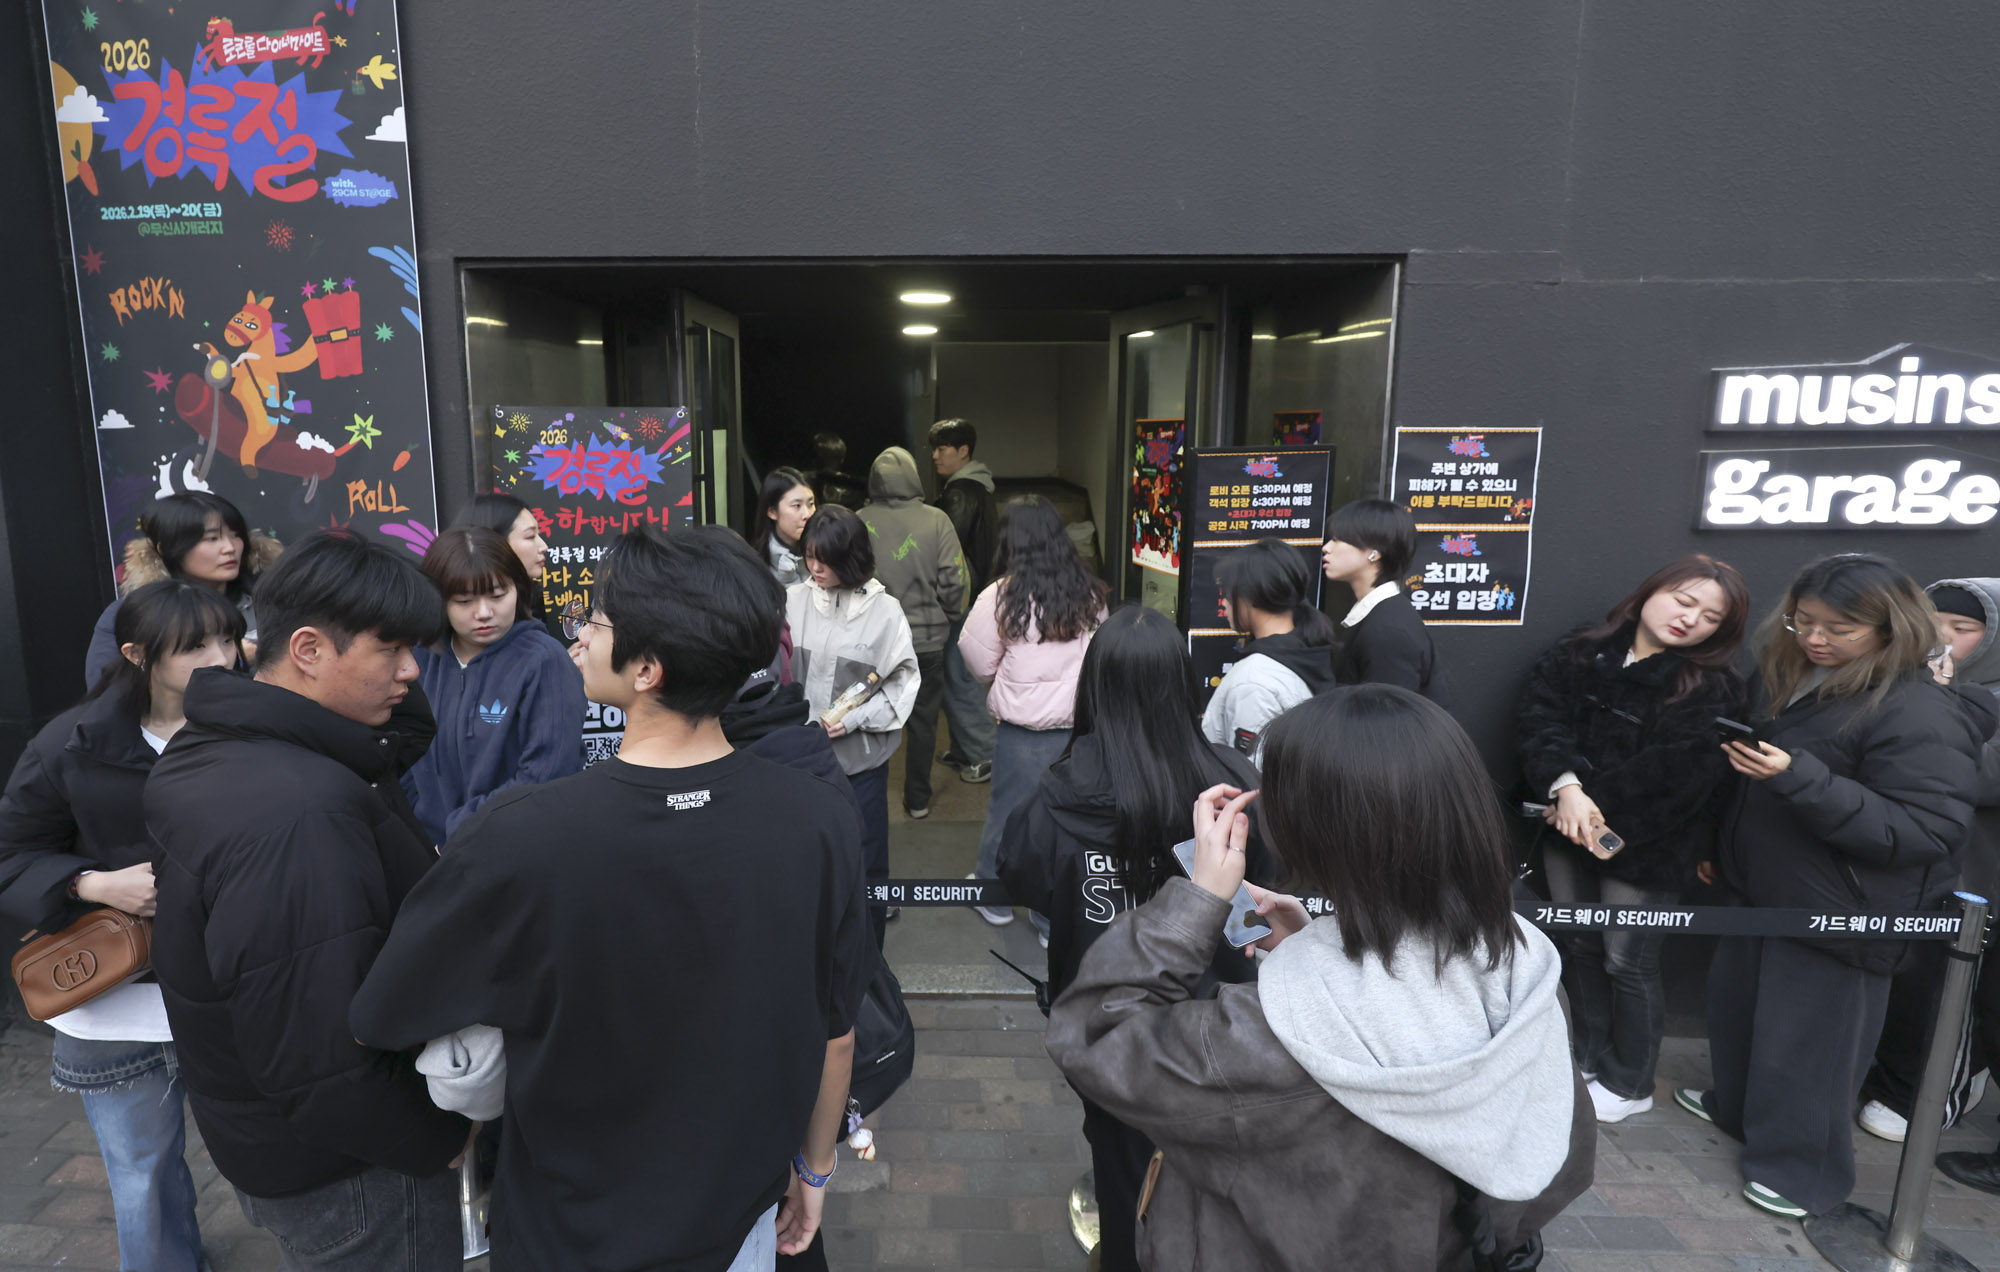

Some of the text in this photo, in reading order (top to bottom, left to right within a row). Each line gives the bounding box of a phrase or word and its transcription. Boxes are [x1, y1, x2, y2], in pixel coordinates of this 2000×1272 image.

[101, 38, 150, 72] 2026
[113, 68, 319, 203] 경록절
[331, 179, 357, 188] with.
[332, 188, 357, 197] 29CM
[138, 221, 224, 237] @무신사개러지
[108, 276, 185, 327] ROCK'N
[540, 429, 568, 445] 2026
[543, 443, 649, 506] 경록절
[1431, 462, 1499, 476] 주변 상가에
[1209, 483, 1313, 496] 로비 오픈 5:30PM 예정
[1408, 479, 1448, 492] 피해가
[1465, 479, 1479, 492] 수
[1481, 479, 1518, 492] 있으니
[1706, 458, 2000, 524] garage
[346, 479, 410, 517] ROLL
[1209, 495, 1312, 509] 객석 입장 6:30PM 예정
[1437, 495, 1514, 508] 부탁드립니다
[1208, 518, 1311, 531] 공연 시작 7:00PM 예정
[547, 545, 585, 564] 경록절
[1423, 561, 1490, 583] 초대자
[1410, 590, 1499, 611] 우선 입장
[666, 789, 711, 807] STRANGER
[674, 799, 705, 811] THINGS
[867, 885, 983, 901] 웨이 SECURITY
[1535, 907, 1695, 927] 가드웨이 SECURITY
[1808, 915, 1962, 933] 가드웨이 SECURIT
